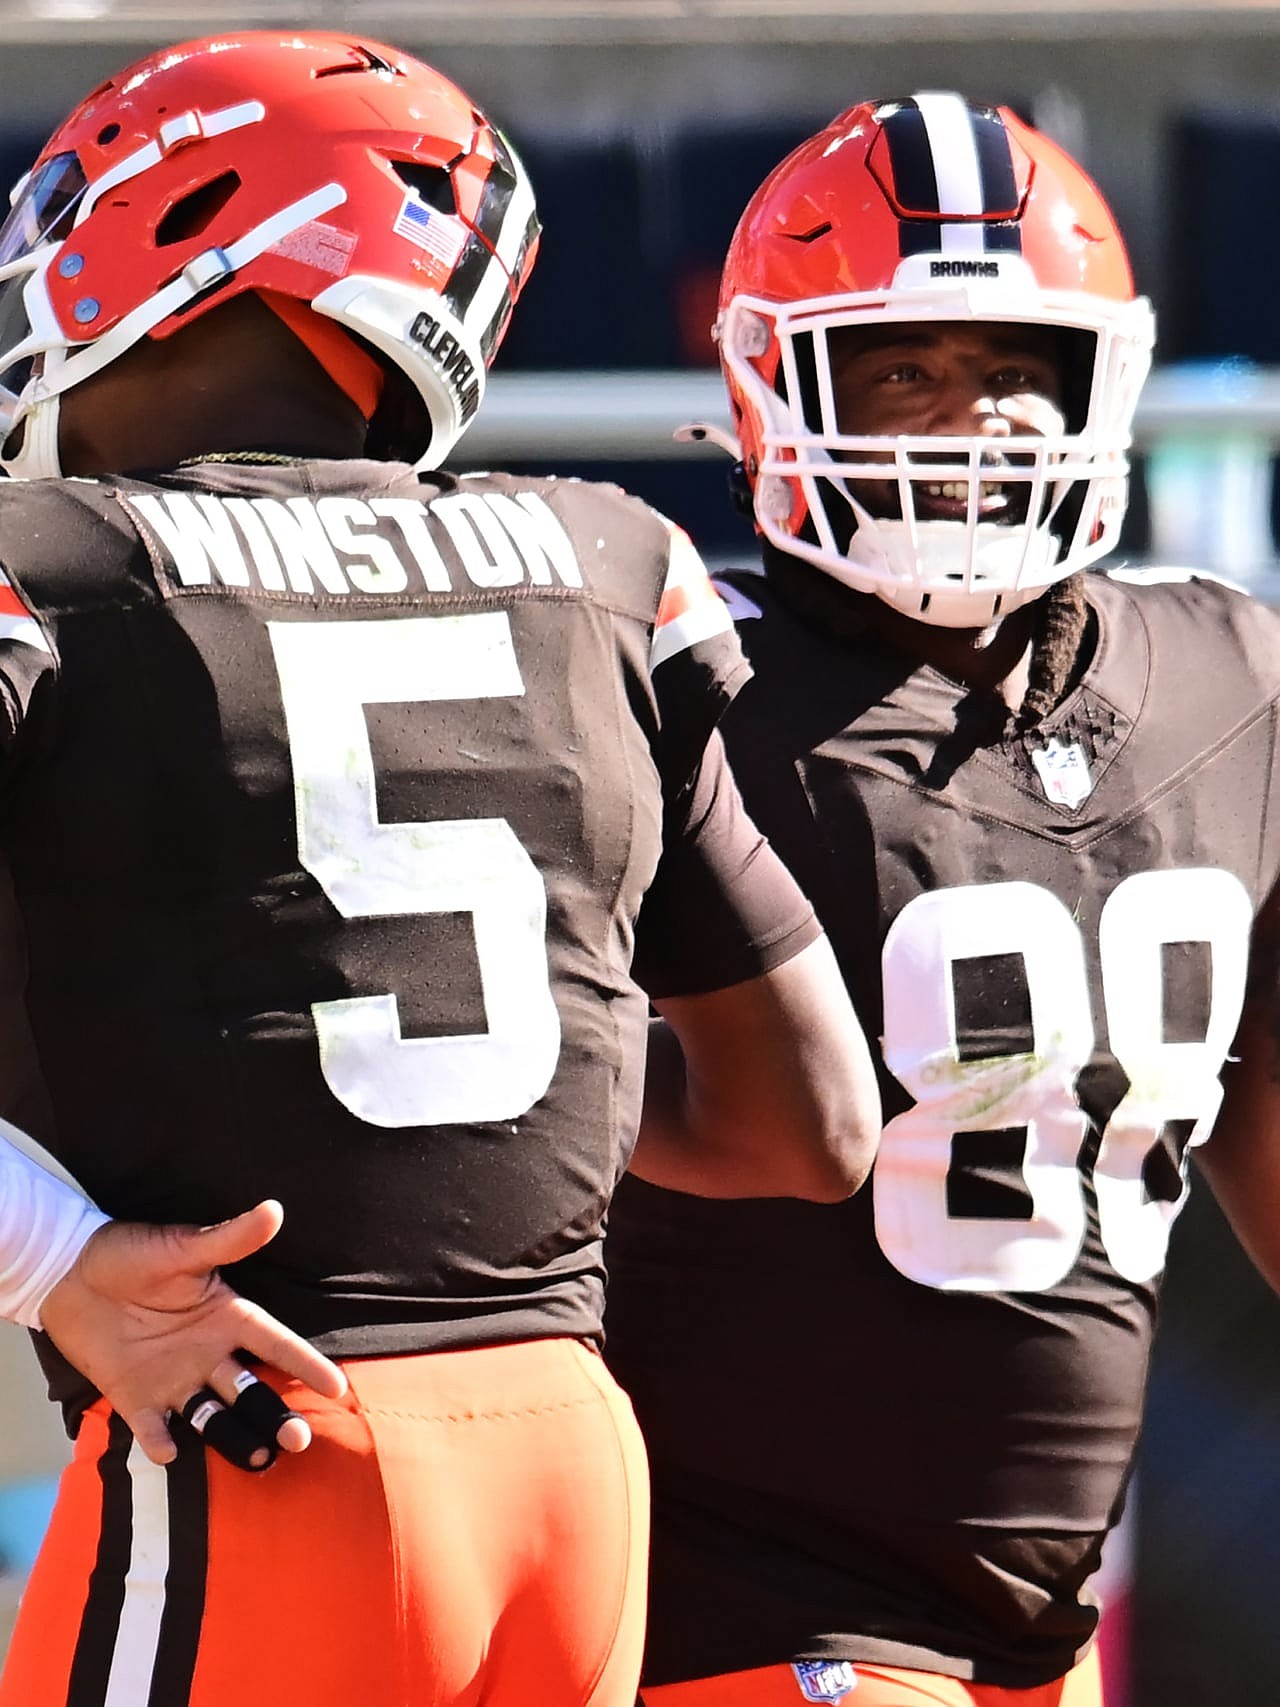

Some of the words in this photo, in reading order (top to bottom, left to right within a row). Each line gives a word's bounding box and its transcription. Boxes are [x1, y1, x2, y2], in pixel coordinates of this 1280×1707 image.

[930, 261, 999, 278] BROWNS
[127, 491, 584, 596] WINSTON
[266, 611, 562, 1129] 5
[873, 867, 1254, 1292] 88
